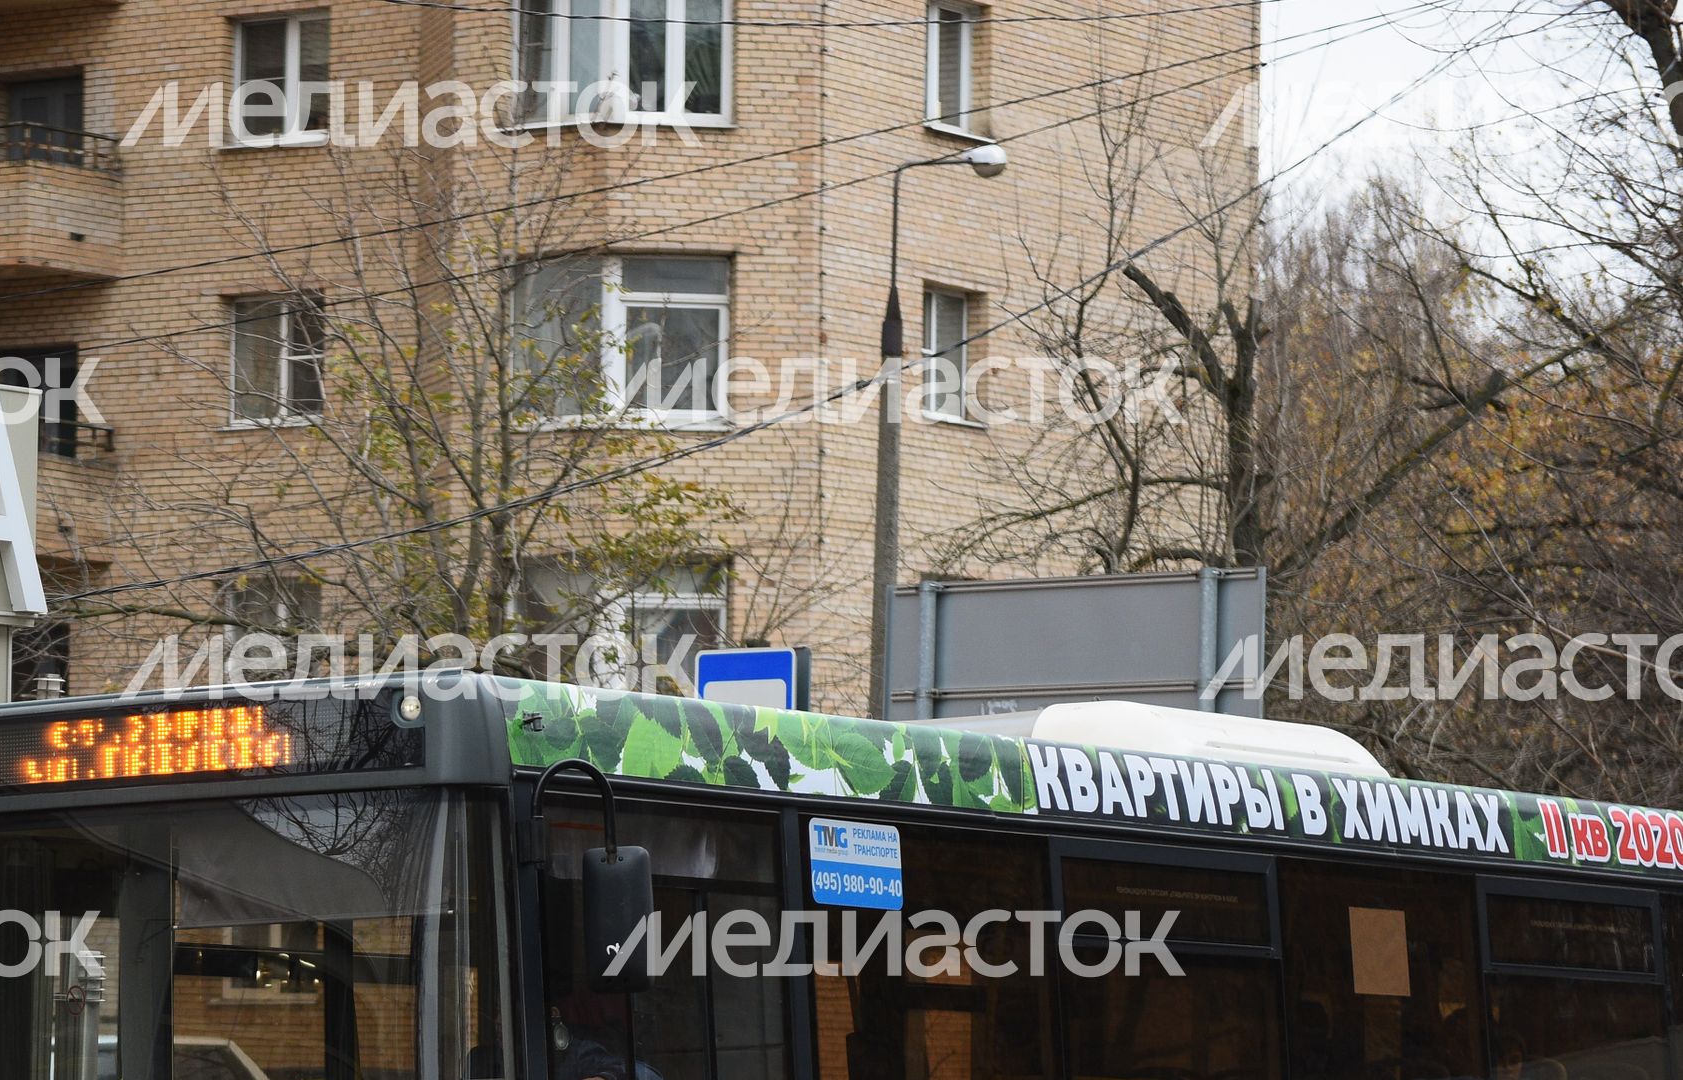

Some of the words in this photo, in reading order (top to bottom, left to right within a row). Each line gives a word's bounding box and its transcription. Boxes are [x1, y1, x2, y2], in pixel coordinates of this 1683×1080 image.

[1028, 744, 1286, 831] КВАРТИРЫ
[1331, 778, 1510, 853] ХИМКАХ
[814, 824, 848, 848] TMG
[852, 828, 886, 842] РЕКЛАМА
[887, 832, 898, 843] НА
[853, 844, 898, 858] ТРАНСПОРТЕ
[812, 869, 841, 895] (495)
[843, 873, 902, 897] 980-90-40
